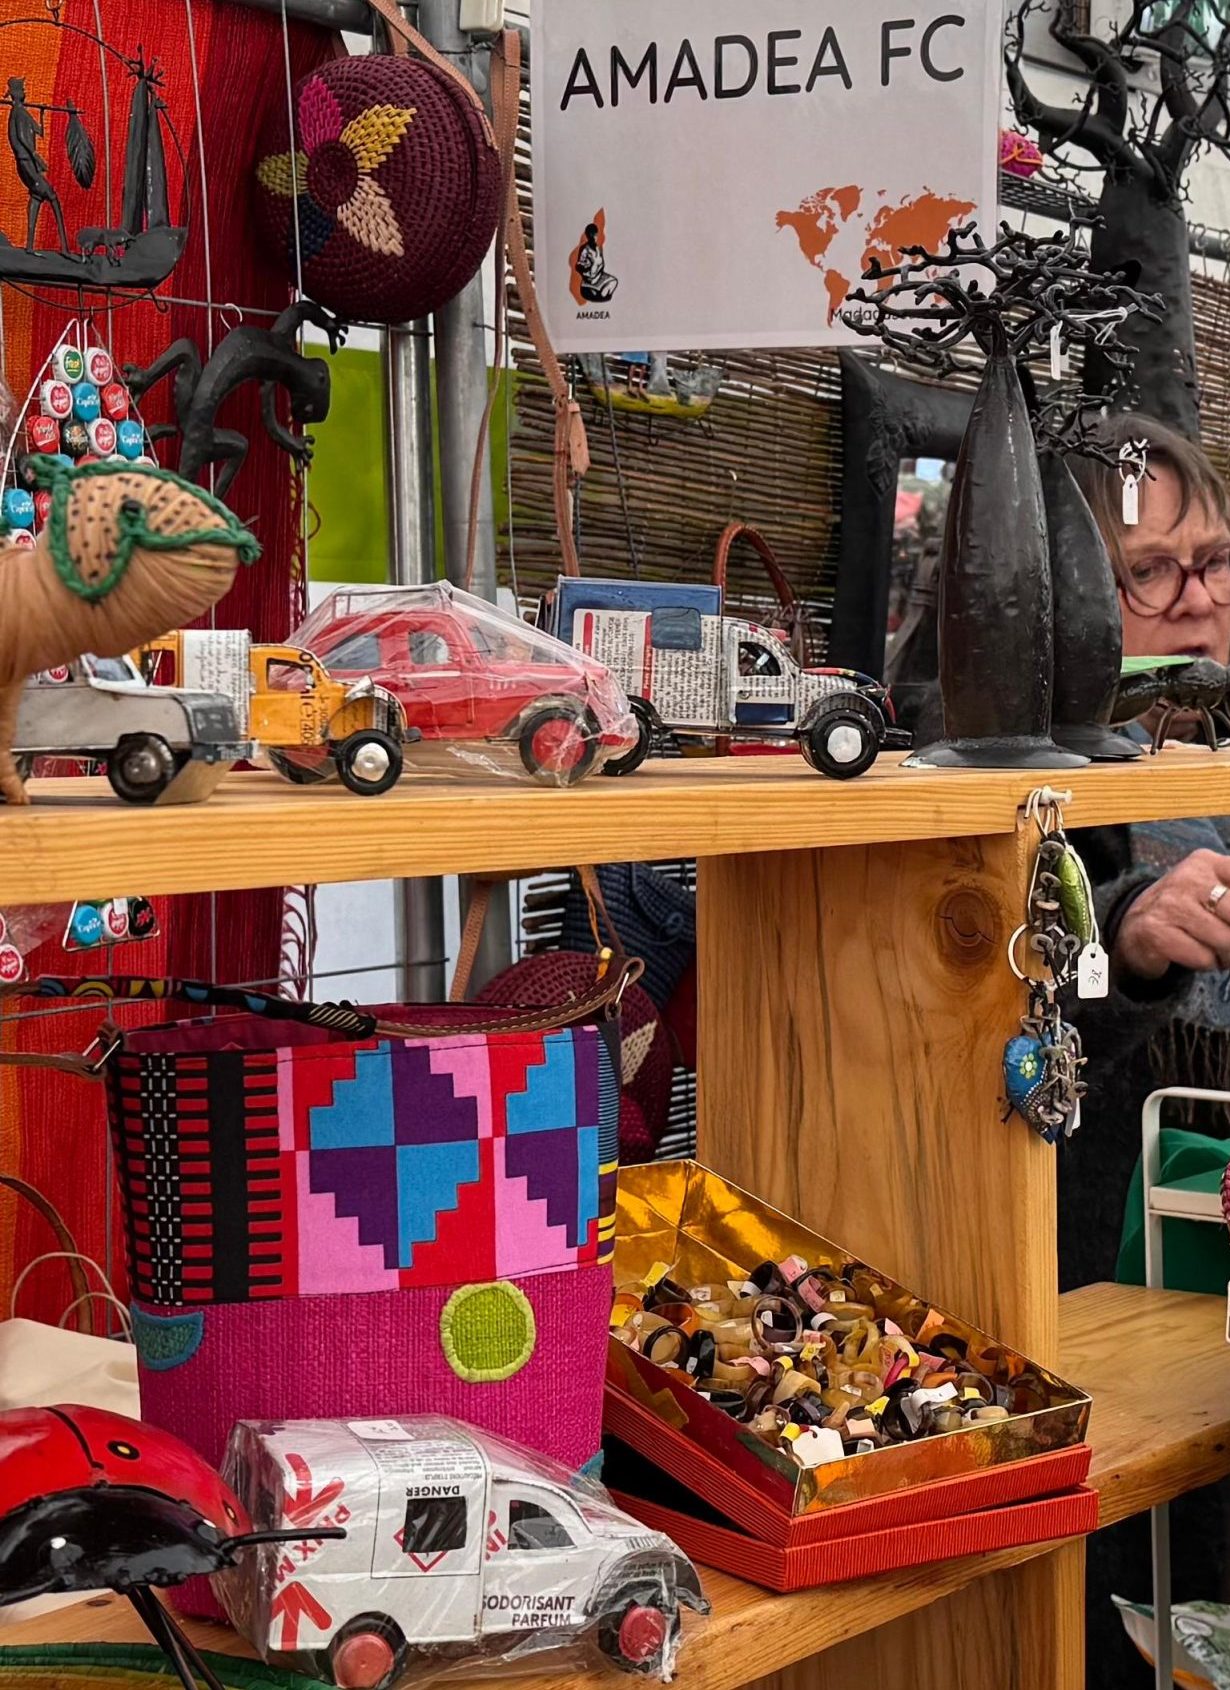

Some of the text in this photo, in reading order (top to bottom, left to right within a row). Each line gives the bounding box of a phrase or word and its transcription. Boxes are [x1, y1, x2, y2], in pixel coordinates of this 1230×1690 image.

[560, 14, 966, 111] AMADEA FC
[575, 311, 610, 320] AMADEA
[405, 1485, 461, 1497] DANGER
[511, 1612, 573, 1627] PARFUM
